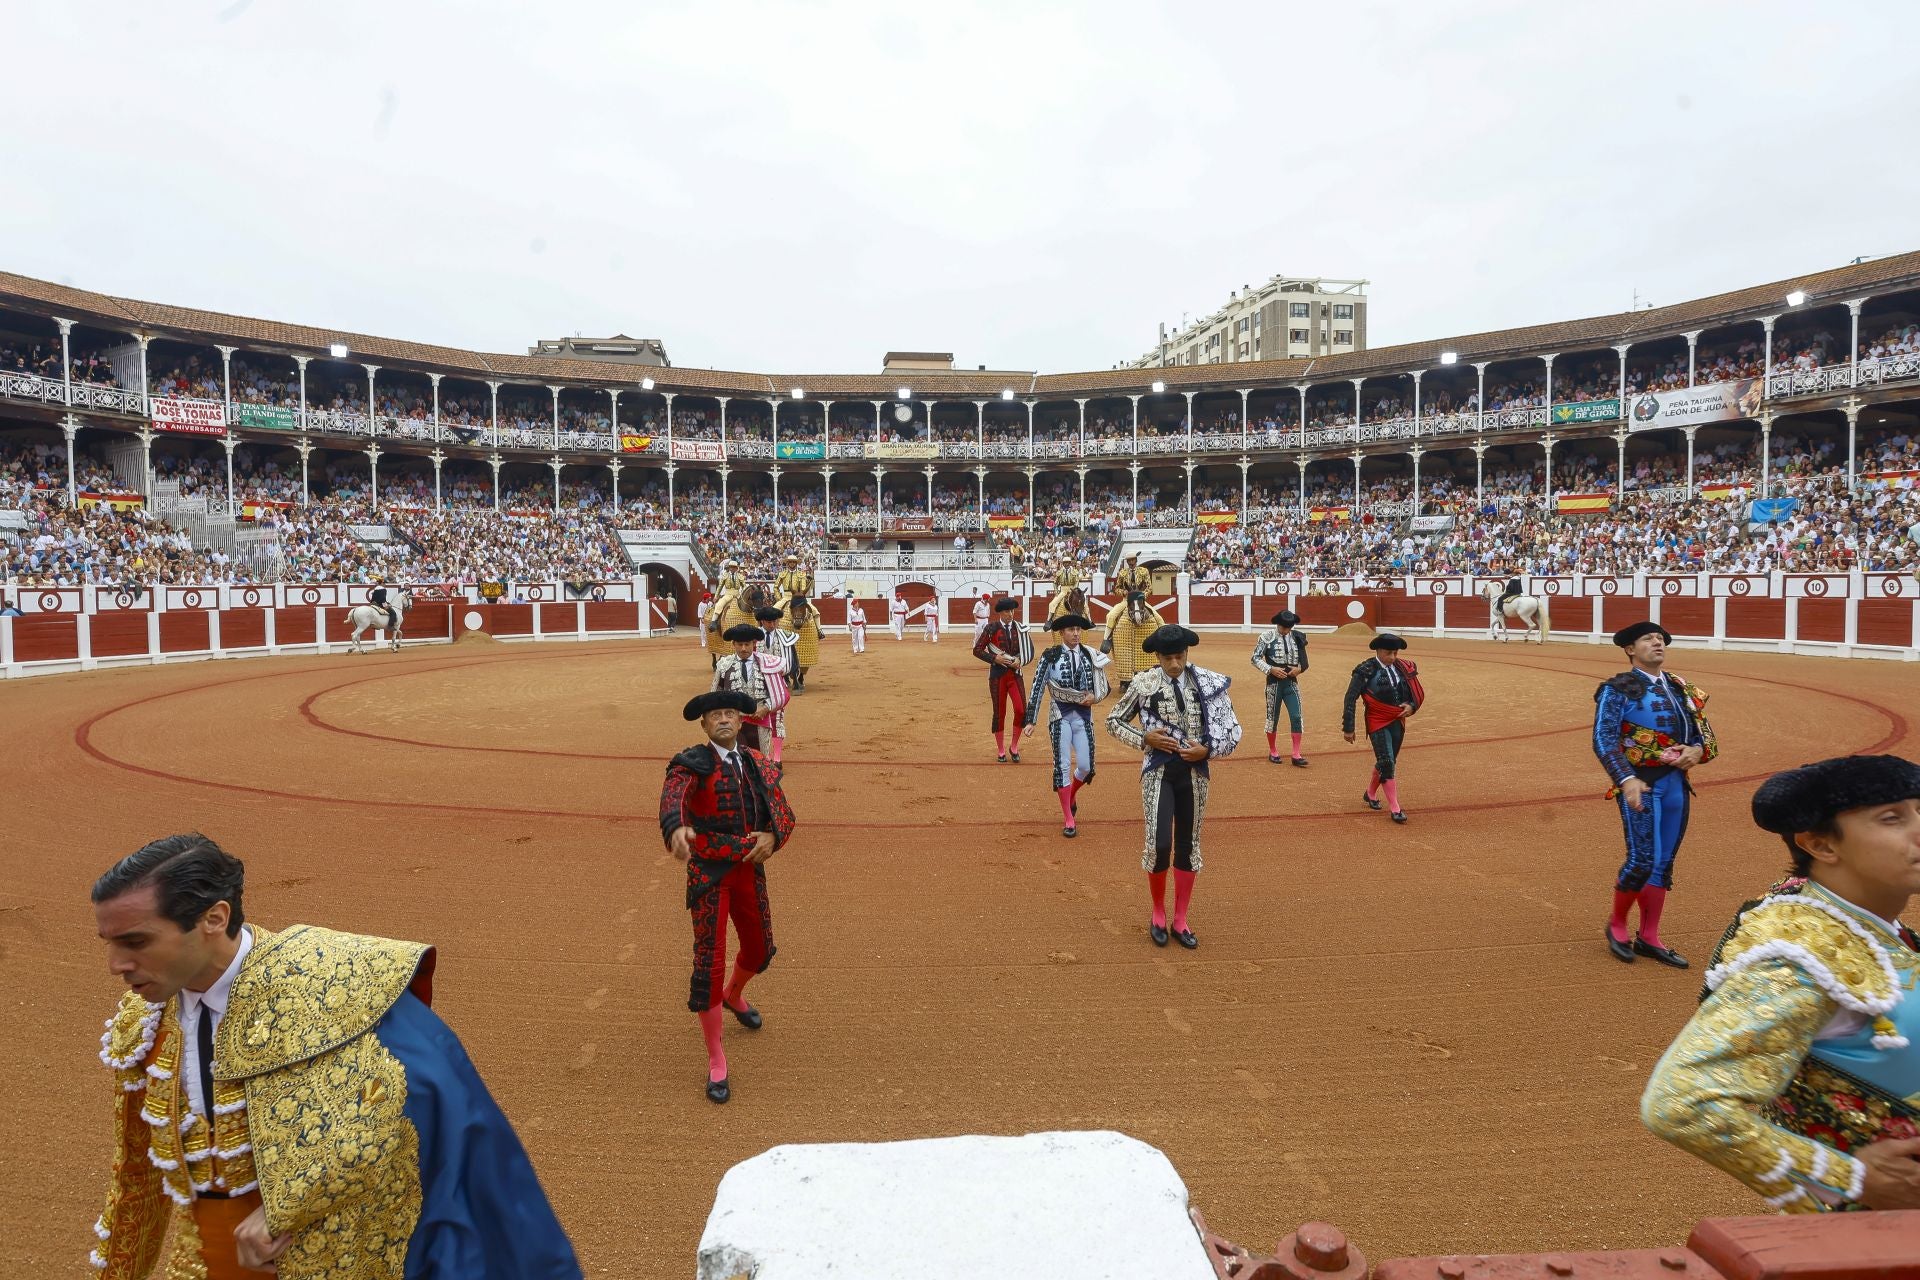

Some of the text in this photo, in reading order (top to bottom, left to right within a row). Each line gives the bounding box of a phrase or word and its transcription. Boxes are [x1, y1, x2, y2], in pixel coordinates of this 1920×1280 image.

[1690, 395, 1723, 405] TAURINA
[182, 402, 222, 410] TAURINA
[1690, 406, 1702, 414] DE
[155, 421, 223, 433] 26 ANIVERSARIO
[892, 574, 936, 586] TORILES
[1547, 583, 1555, 591] 10
[1605, 583, 1613, 591] 10
[1668, 583, 1676, 591] 10
[1735, 583, 1745, 591] 10
[1812, 583, 1821, 591] 10
[1889, 583, 1895, 591] 8
[121, 595, 128, 604] 9
[190, 595, 195, 603] 9
[249, 593, 254, 601] 9
[308, 592, 315, 600] 11
[47, 597, 53, 606] 9
